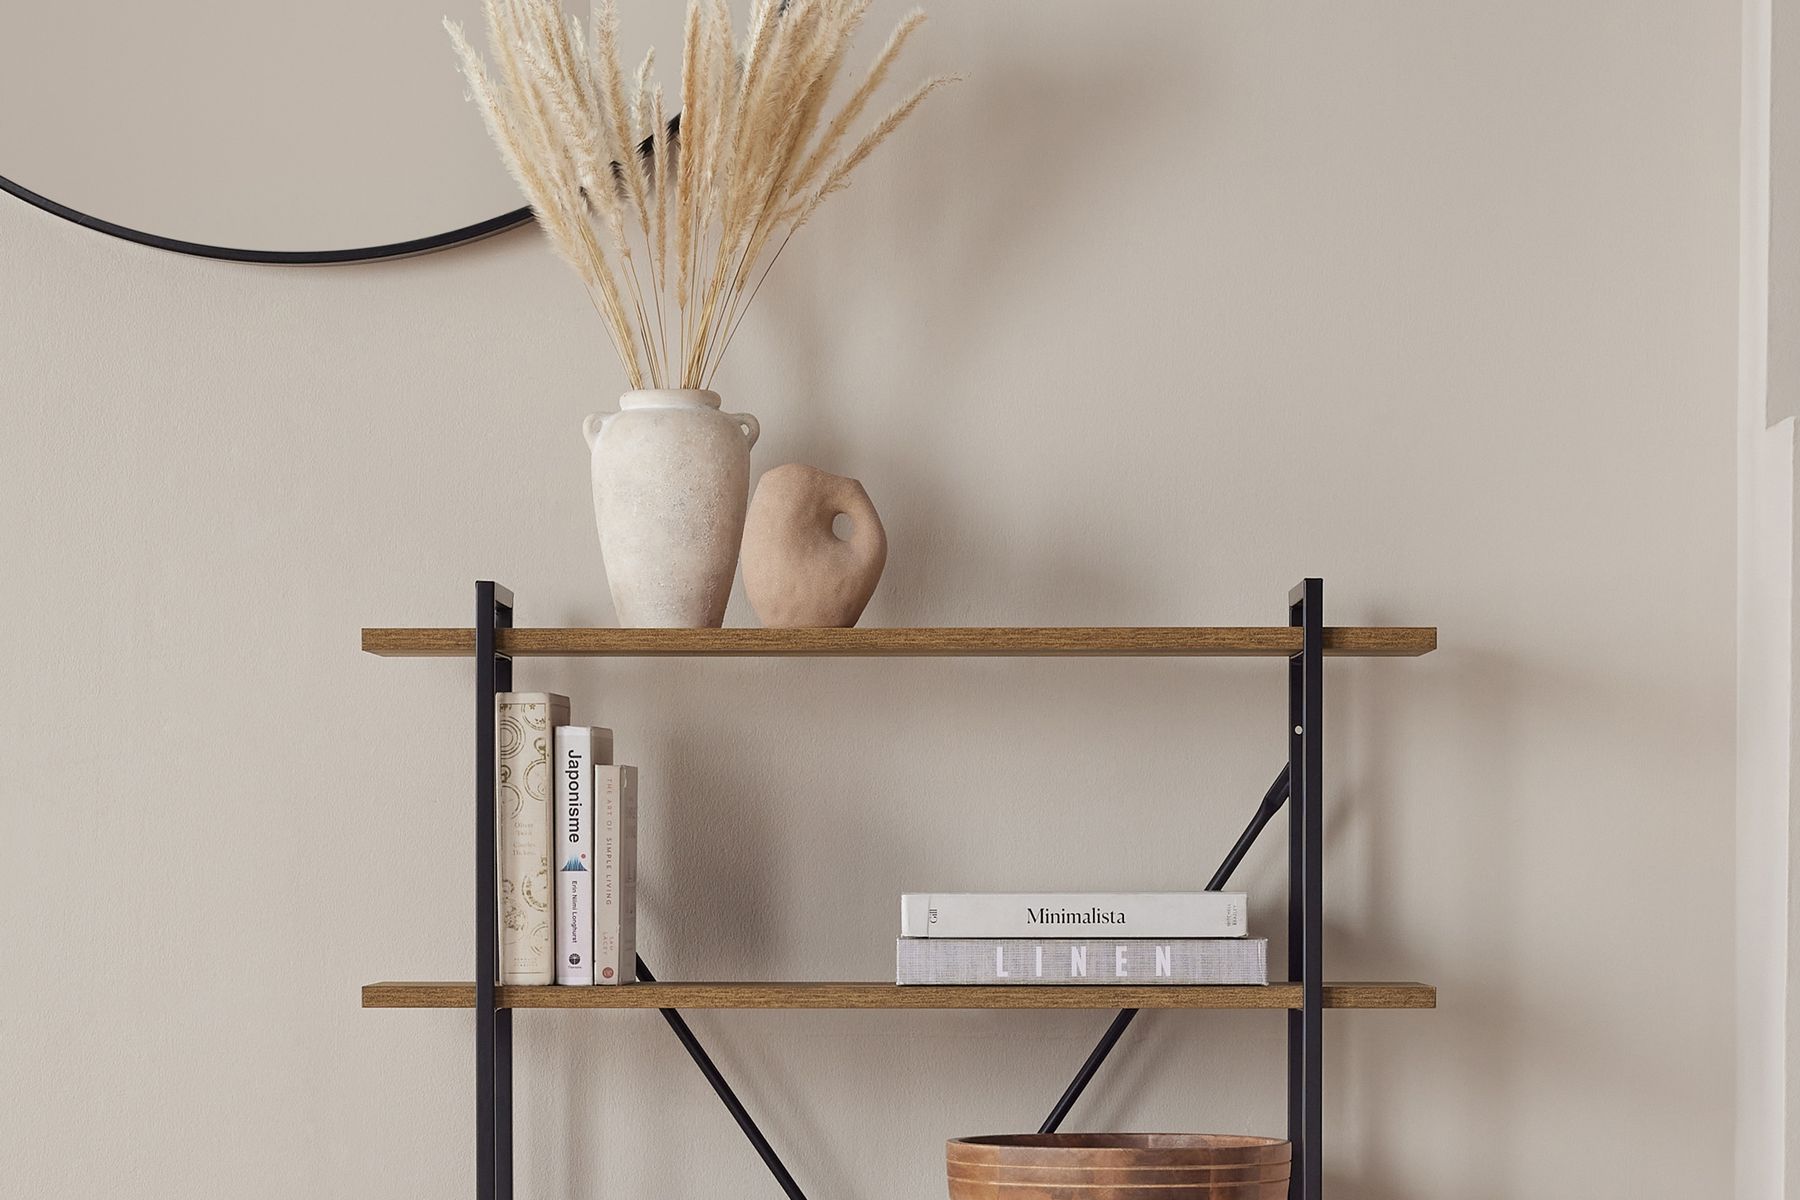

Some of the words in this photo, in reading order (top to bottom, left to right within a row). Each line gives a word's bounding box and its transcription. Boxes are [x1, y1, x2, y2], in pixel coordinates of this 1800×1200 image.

[565, 750, 583, 843] Japonisme
[606, 820, 613, 832] OF
[570, 880, 578, 893] Erin
[605, 874, 613, 905] LIVING
[570, 911, 578, 943] Longhurst
[929, 908, 938, 924] Gill
[1026, 907, 1126, 925] Minimalista
[995, 945, 1172, 978] LINEN
